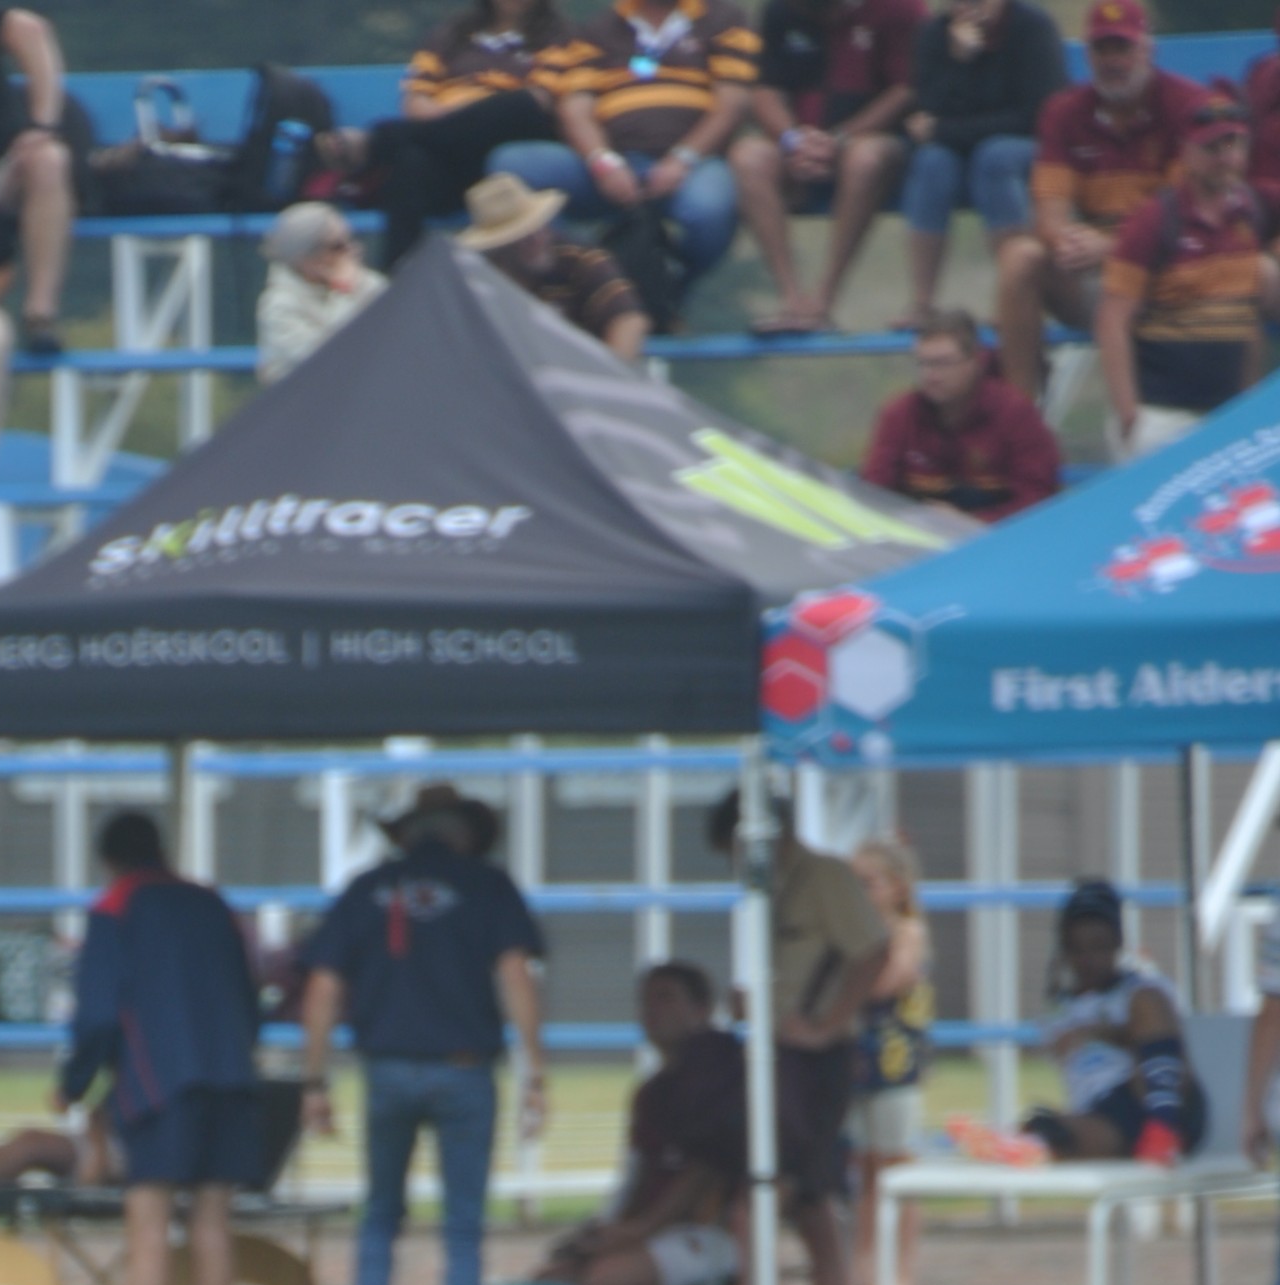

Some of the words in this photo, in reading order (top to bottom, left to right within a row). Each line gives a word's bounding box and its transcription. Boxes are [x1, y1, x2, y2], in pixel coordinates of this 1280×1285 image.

[89, 493, 531, 575] skilltracer
[329, 629, 422, 664] HIGH
[426, 629, 579, 664] SCHOOL
[992, 666, 1120, 711] First
[1127, 660, 1280, 706] Aider
